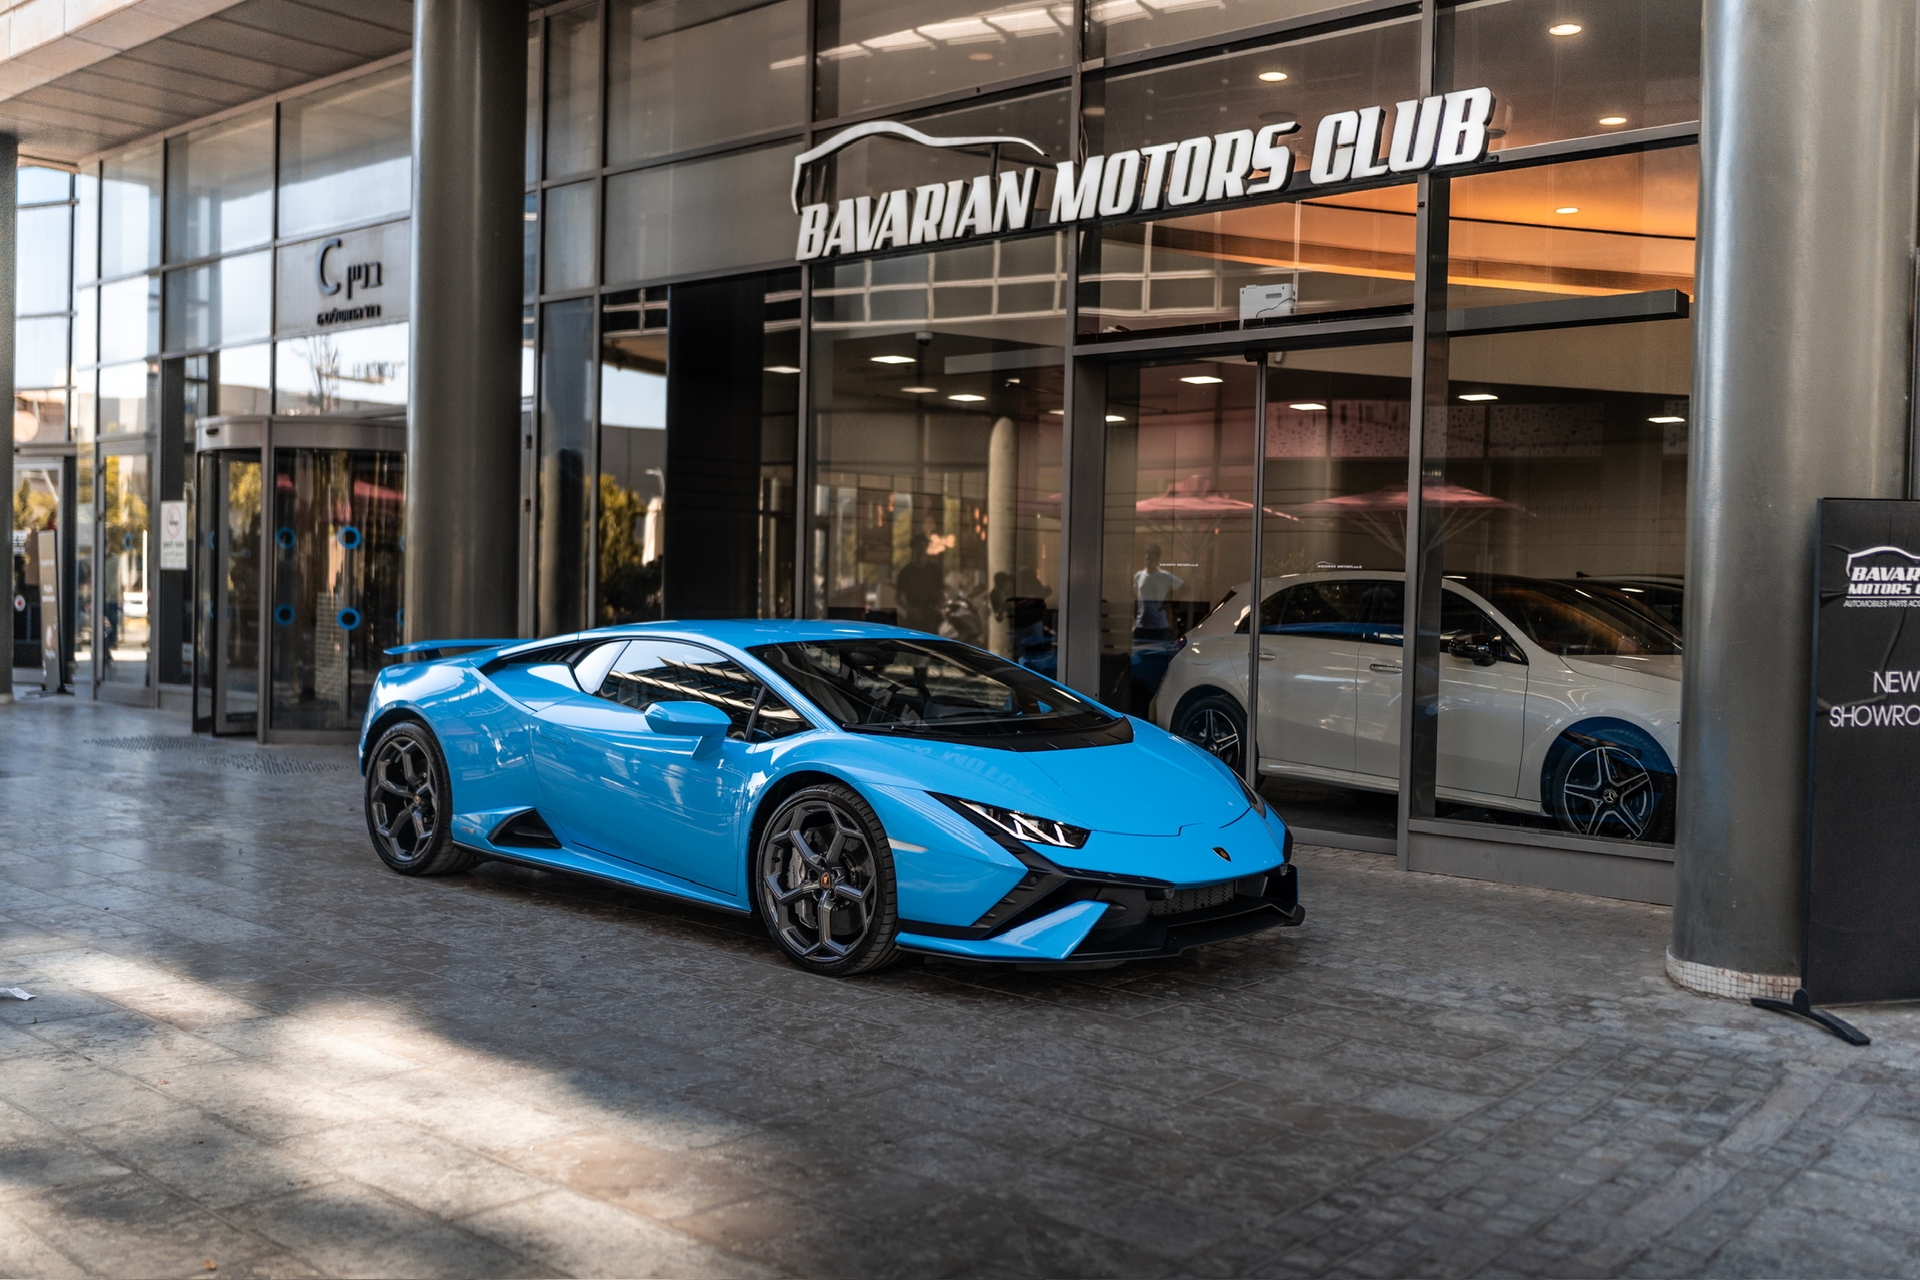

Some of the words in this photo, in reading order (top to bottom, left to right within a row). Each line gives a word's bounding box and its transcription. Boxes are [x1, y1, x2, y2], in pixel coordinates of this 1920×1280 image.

[795, 166, 1040, 261] BAVARIAN
[1049, 120, 1300, 224] MOTORS
[1309, 86, 1497, 185] CLUB
[316, 237, 343, 296] C
[346, 260, 383, 301] בניין
[1851, 566, 1920, 581] BAVAR
[1848, 583, 1912, 595] MOTORS
[1873, 670, 1920, 694] NEW
[1829, 704, 1920, 728] SHOWRO
